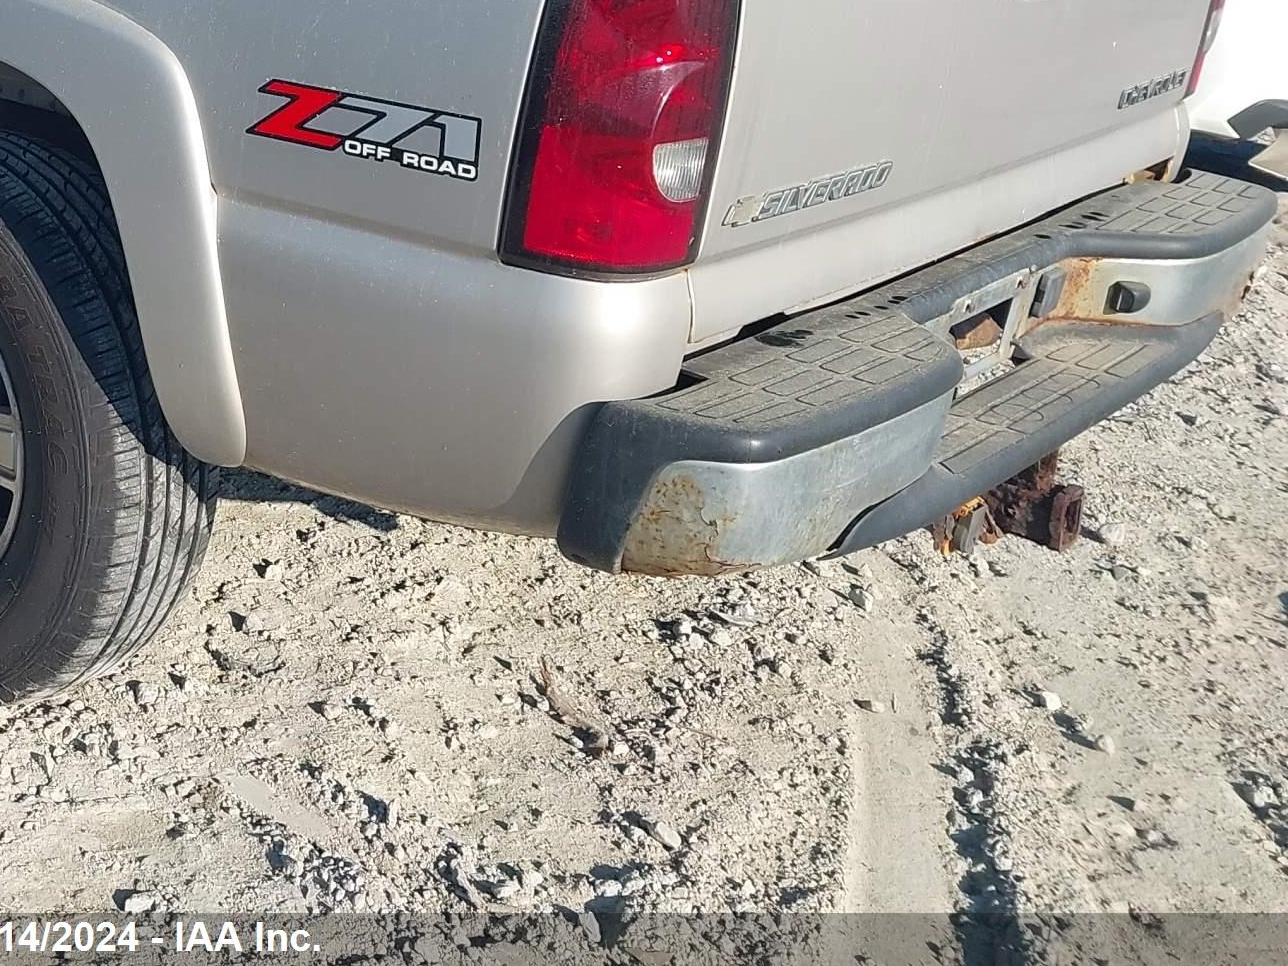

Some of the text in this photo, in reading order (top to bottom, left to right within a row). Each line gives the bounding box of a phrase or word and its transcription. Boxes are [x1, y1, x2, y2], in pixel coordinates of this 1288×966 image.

[246, 79, 482, 163] Z71
[344, 139, 478, 180] OFF ROAD
[758, 161, 894, 218] SILVERADO
